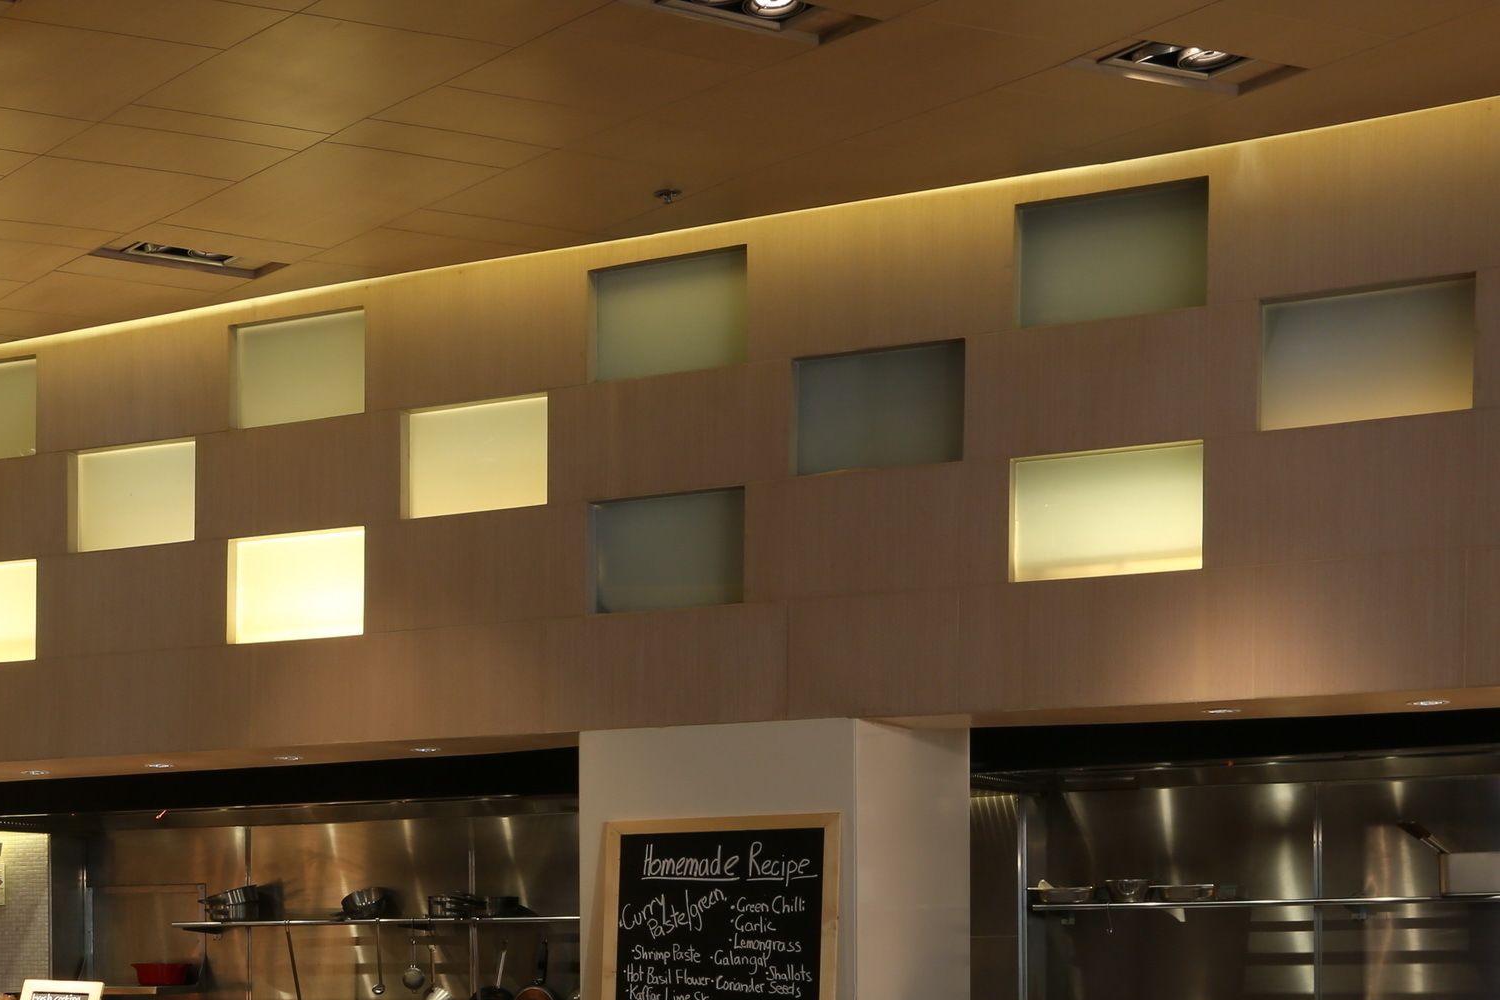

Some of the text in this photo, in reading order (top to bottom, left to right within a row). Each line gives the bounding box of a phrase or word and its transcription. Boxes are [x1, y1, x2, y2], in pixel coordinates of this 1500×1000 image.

[643, 841, 810, 887] Homemade Recipe
[622, 893, 665, 930] Curry
[736, 895, 805, 914] Green Chilli
[735, 914, 776, 933] Garlic
[634, 943, 700, 965] Shrimp Paste
[734, 933, 801, 960] Lemongrass
[627, 963, 710, 986] Hot Basil Flower
[766, 964, 812, 982] Shallots
[716, 975, 801, 998] Coriander Seeds
